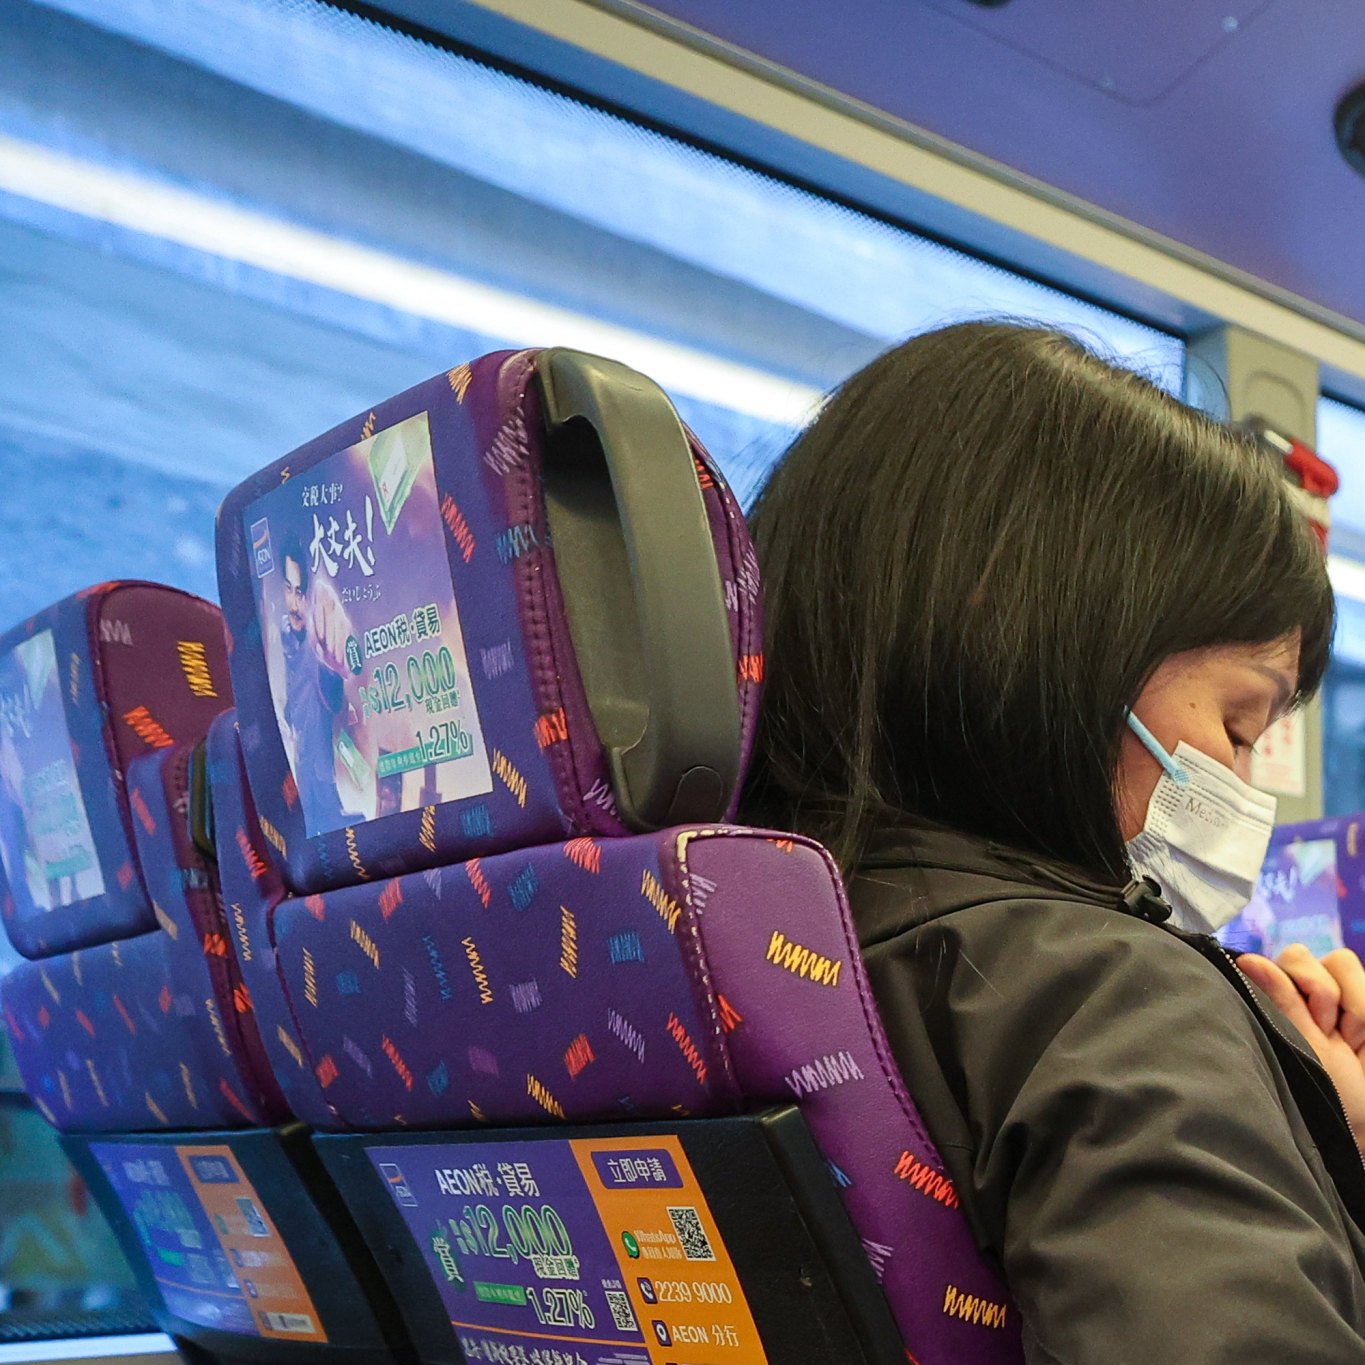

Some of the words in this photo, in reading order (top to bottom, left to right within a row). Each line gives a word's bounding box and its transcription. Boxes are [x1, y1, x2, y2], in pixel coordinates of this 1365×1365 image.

[416, 720, 468, 761] 1.27%
[607, 1158, 666, 1182] 立即申請
[656, 1281, 691, 1302] 2239
[692, 1282, 732, 1304] 9000
[526, 1287, 595, 1330] 1.27%
[672, 1325, 709, 1344] AEON
[712, 1324, 739, 1347] 分行
